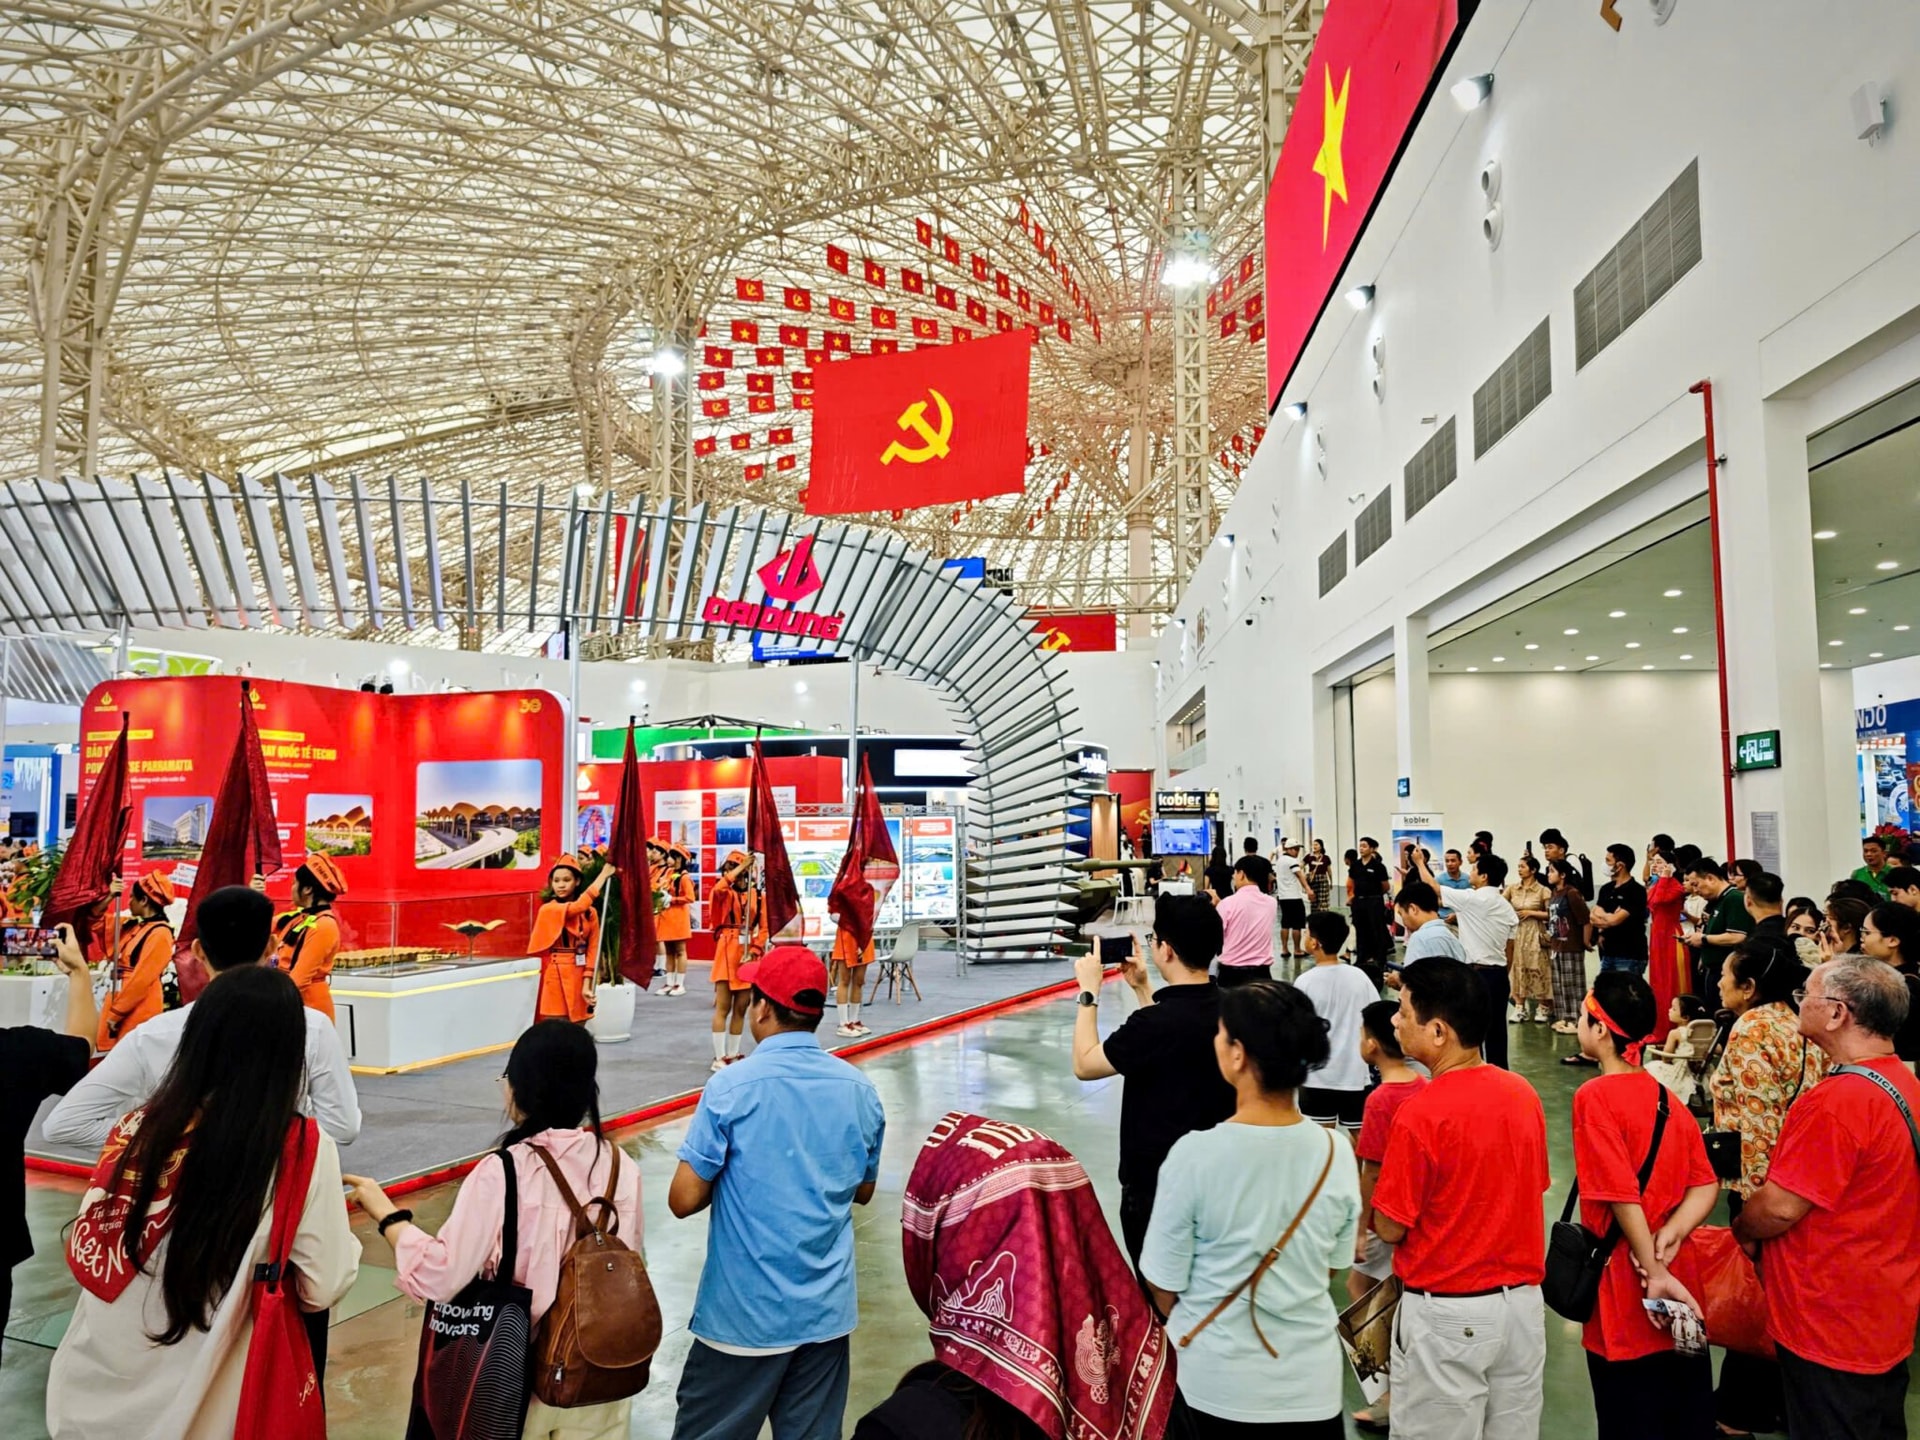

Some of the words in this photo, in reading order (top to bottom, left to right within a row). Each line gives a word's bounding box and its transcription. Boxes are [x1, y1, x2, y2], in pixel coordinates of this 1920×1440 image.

[1158, 792, 1202, 807] kobler
[1403, 816, 1430, 824] kobler
[1867, 1071, 1913, 1119] MICHELIN
